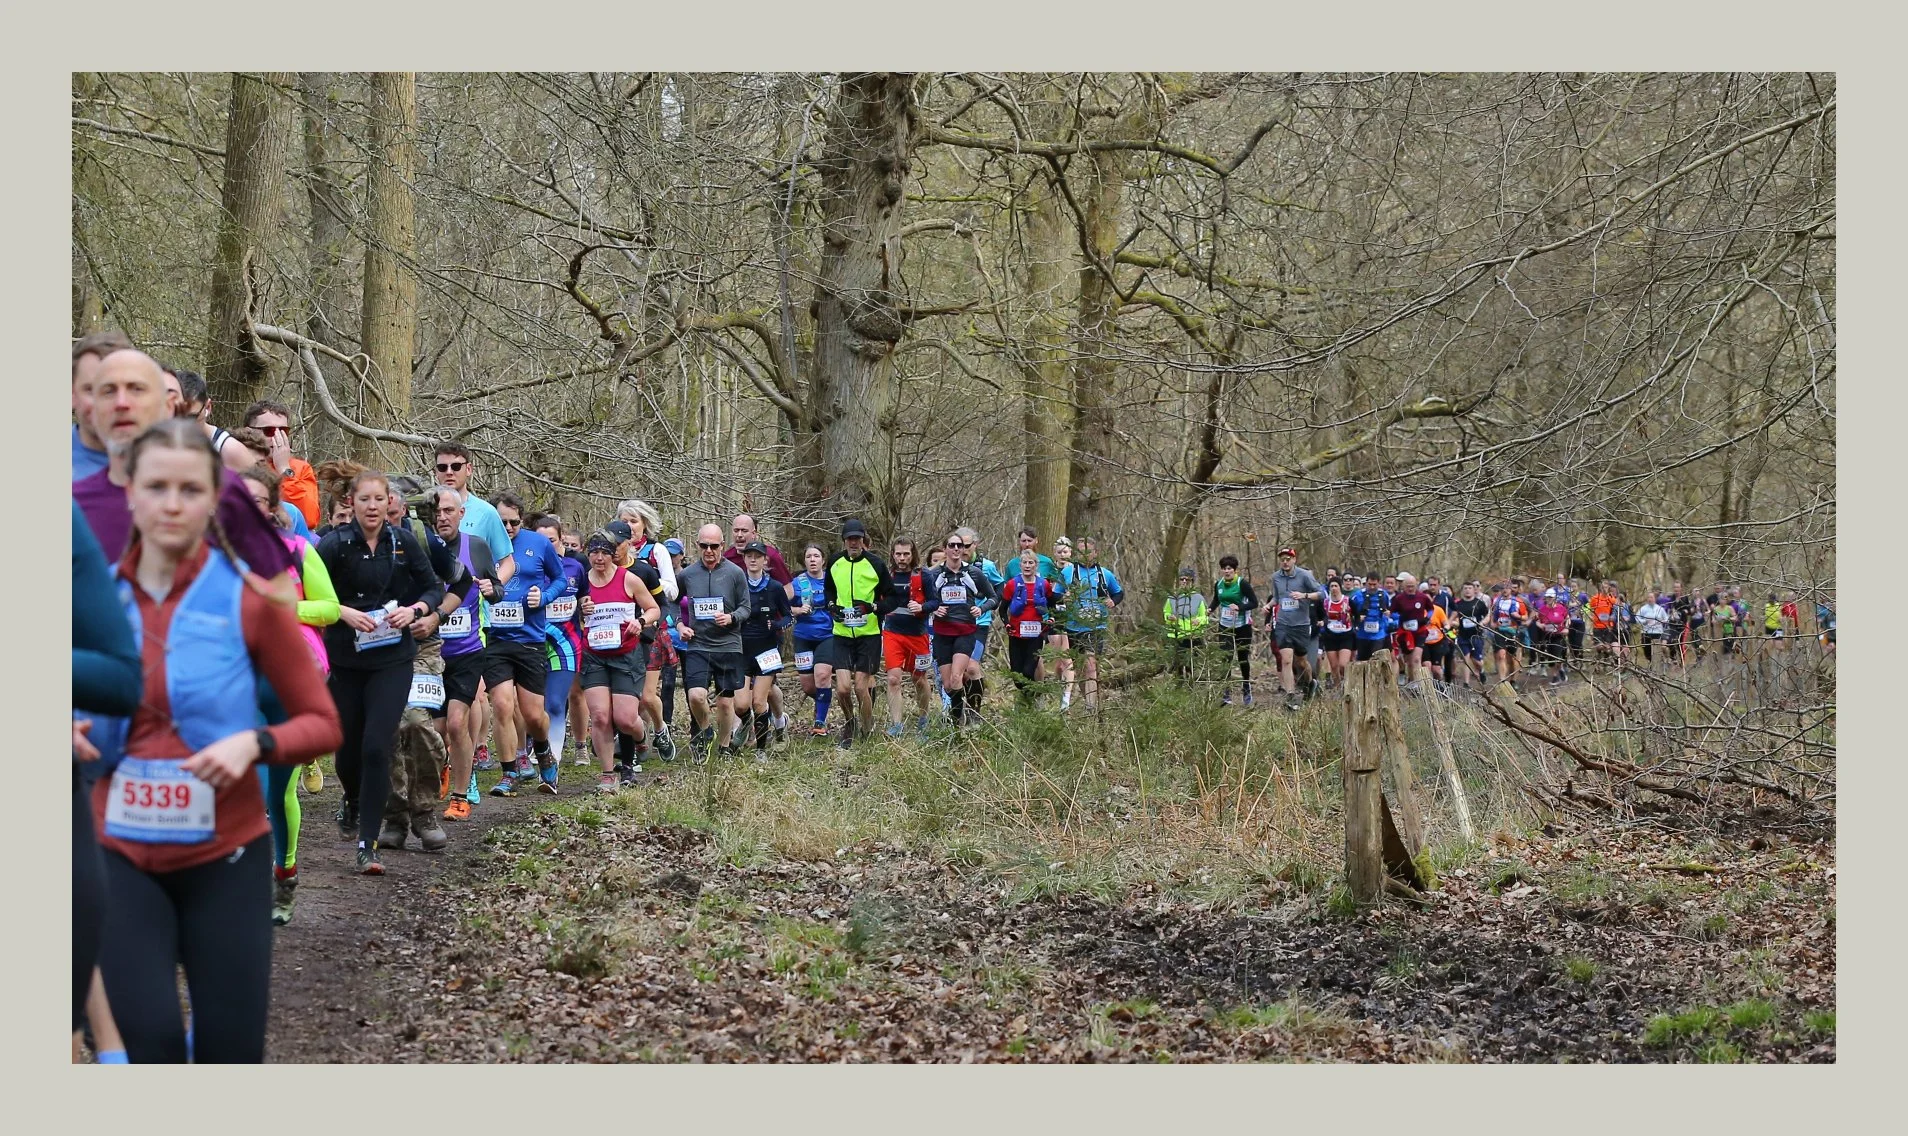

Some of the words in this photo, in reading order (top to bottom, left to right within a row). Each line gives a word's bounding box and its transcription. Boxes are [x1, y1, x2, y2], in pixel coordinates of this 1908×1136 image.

[553, 603, 573, 612] 5164
[699, 603, 718, 611] 5248
[495, 608, 517, 618] 5432
[440, 616, 463, 627] 767
[593, 631, 614, 640] 5639
[417, 684, 442, 696] 5056
[123, 781, 191, 810] 5339
